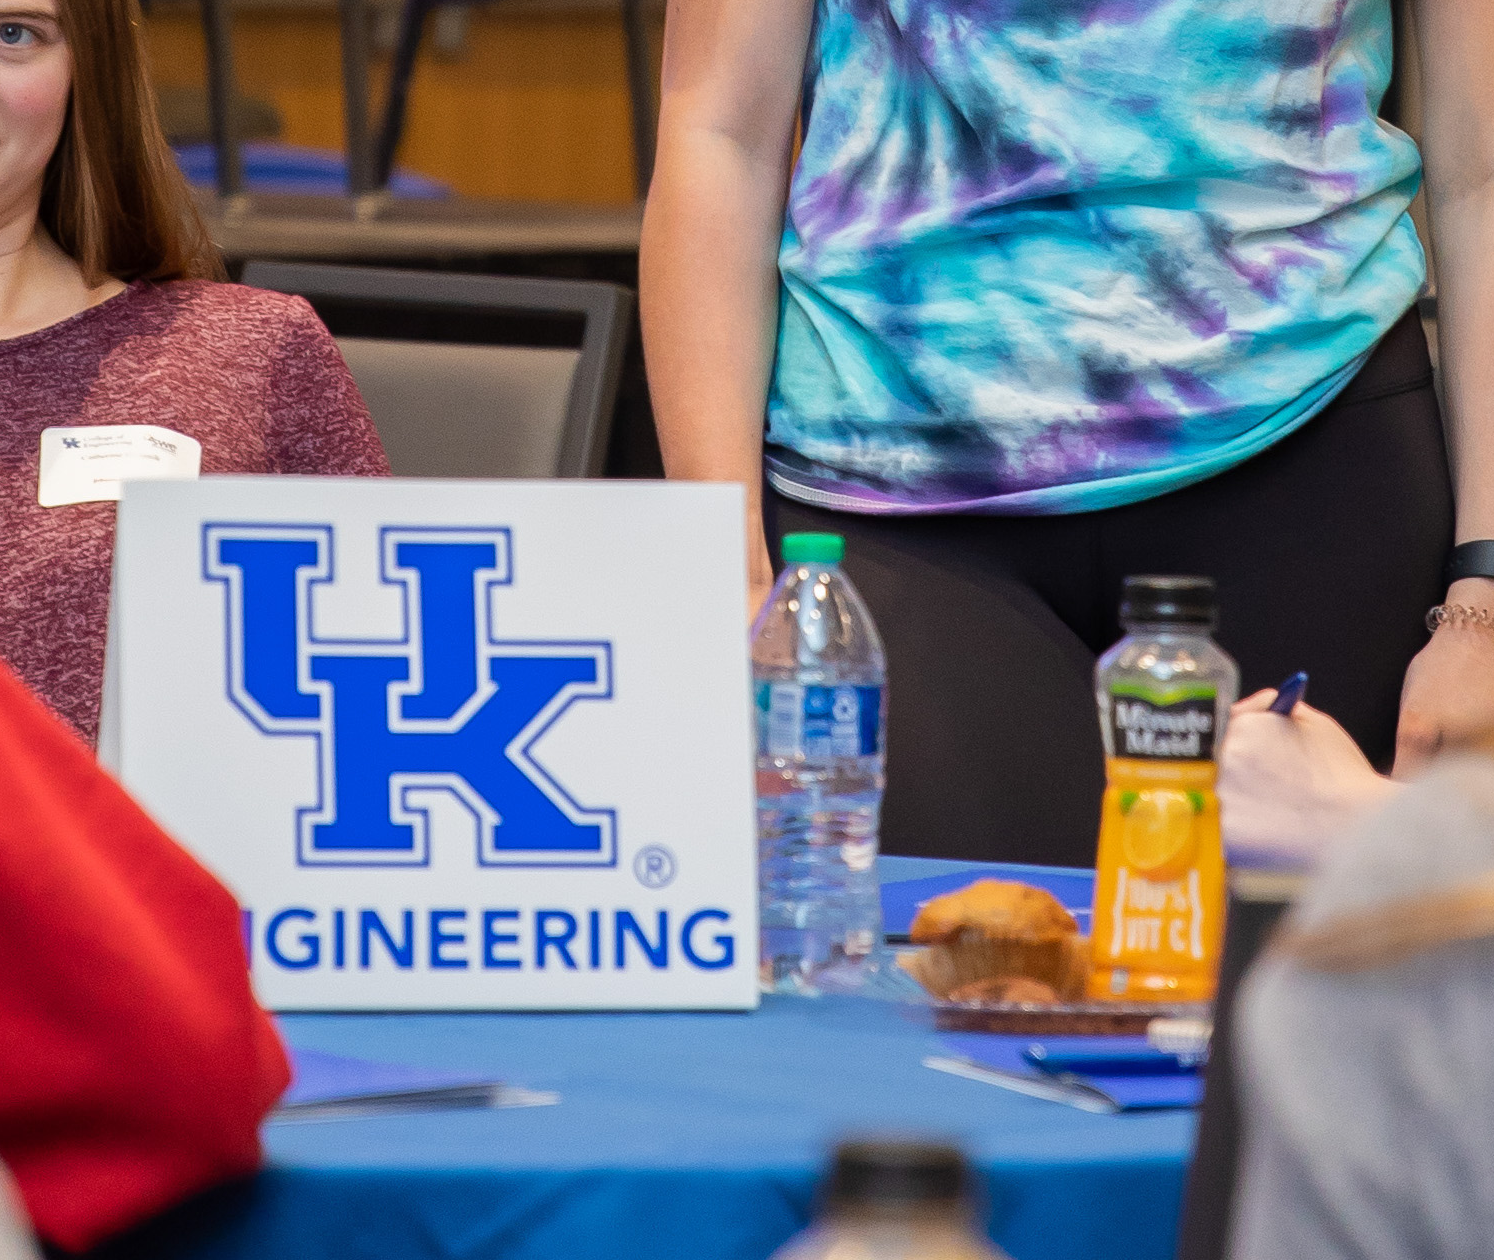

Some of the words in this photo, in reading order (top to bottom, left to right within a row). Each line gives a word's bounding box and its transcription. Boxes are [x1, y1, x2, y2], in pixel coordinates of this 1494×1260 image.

[201, 522, 618, 868] UK
[1126, 728, 1200, 756] Maid
[242, 907, 736, 971] GINEERING
